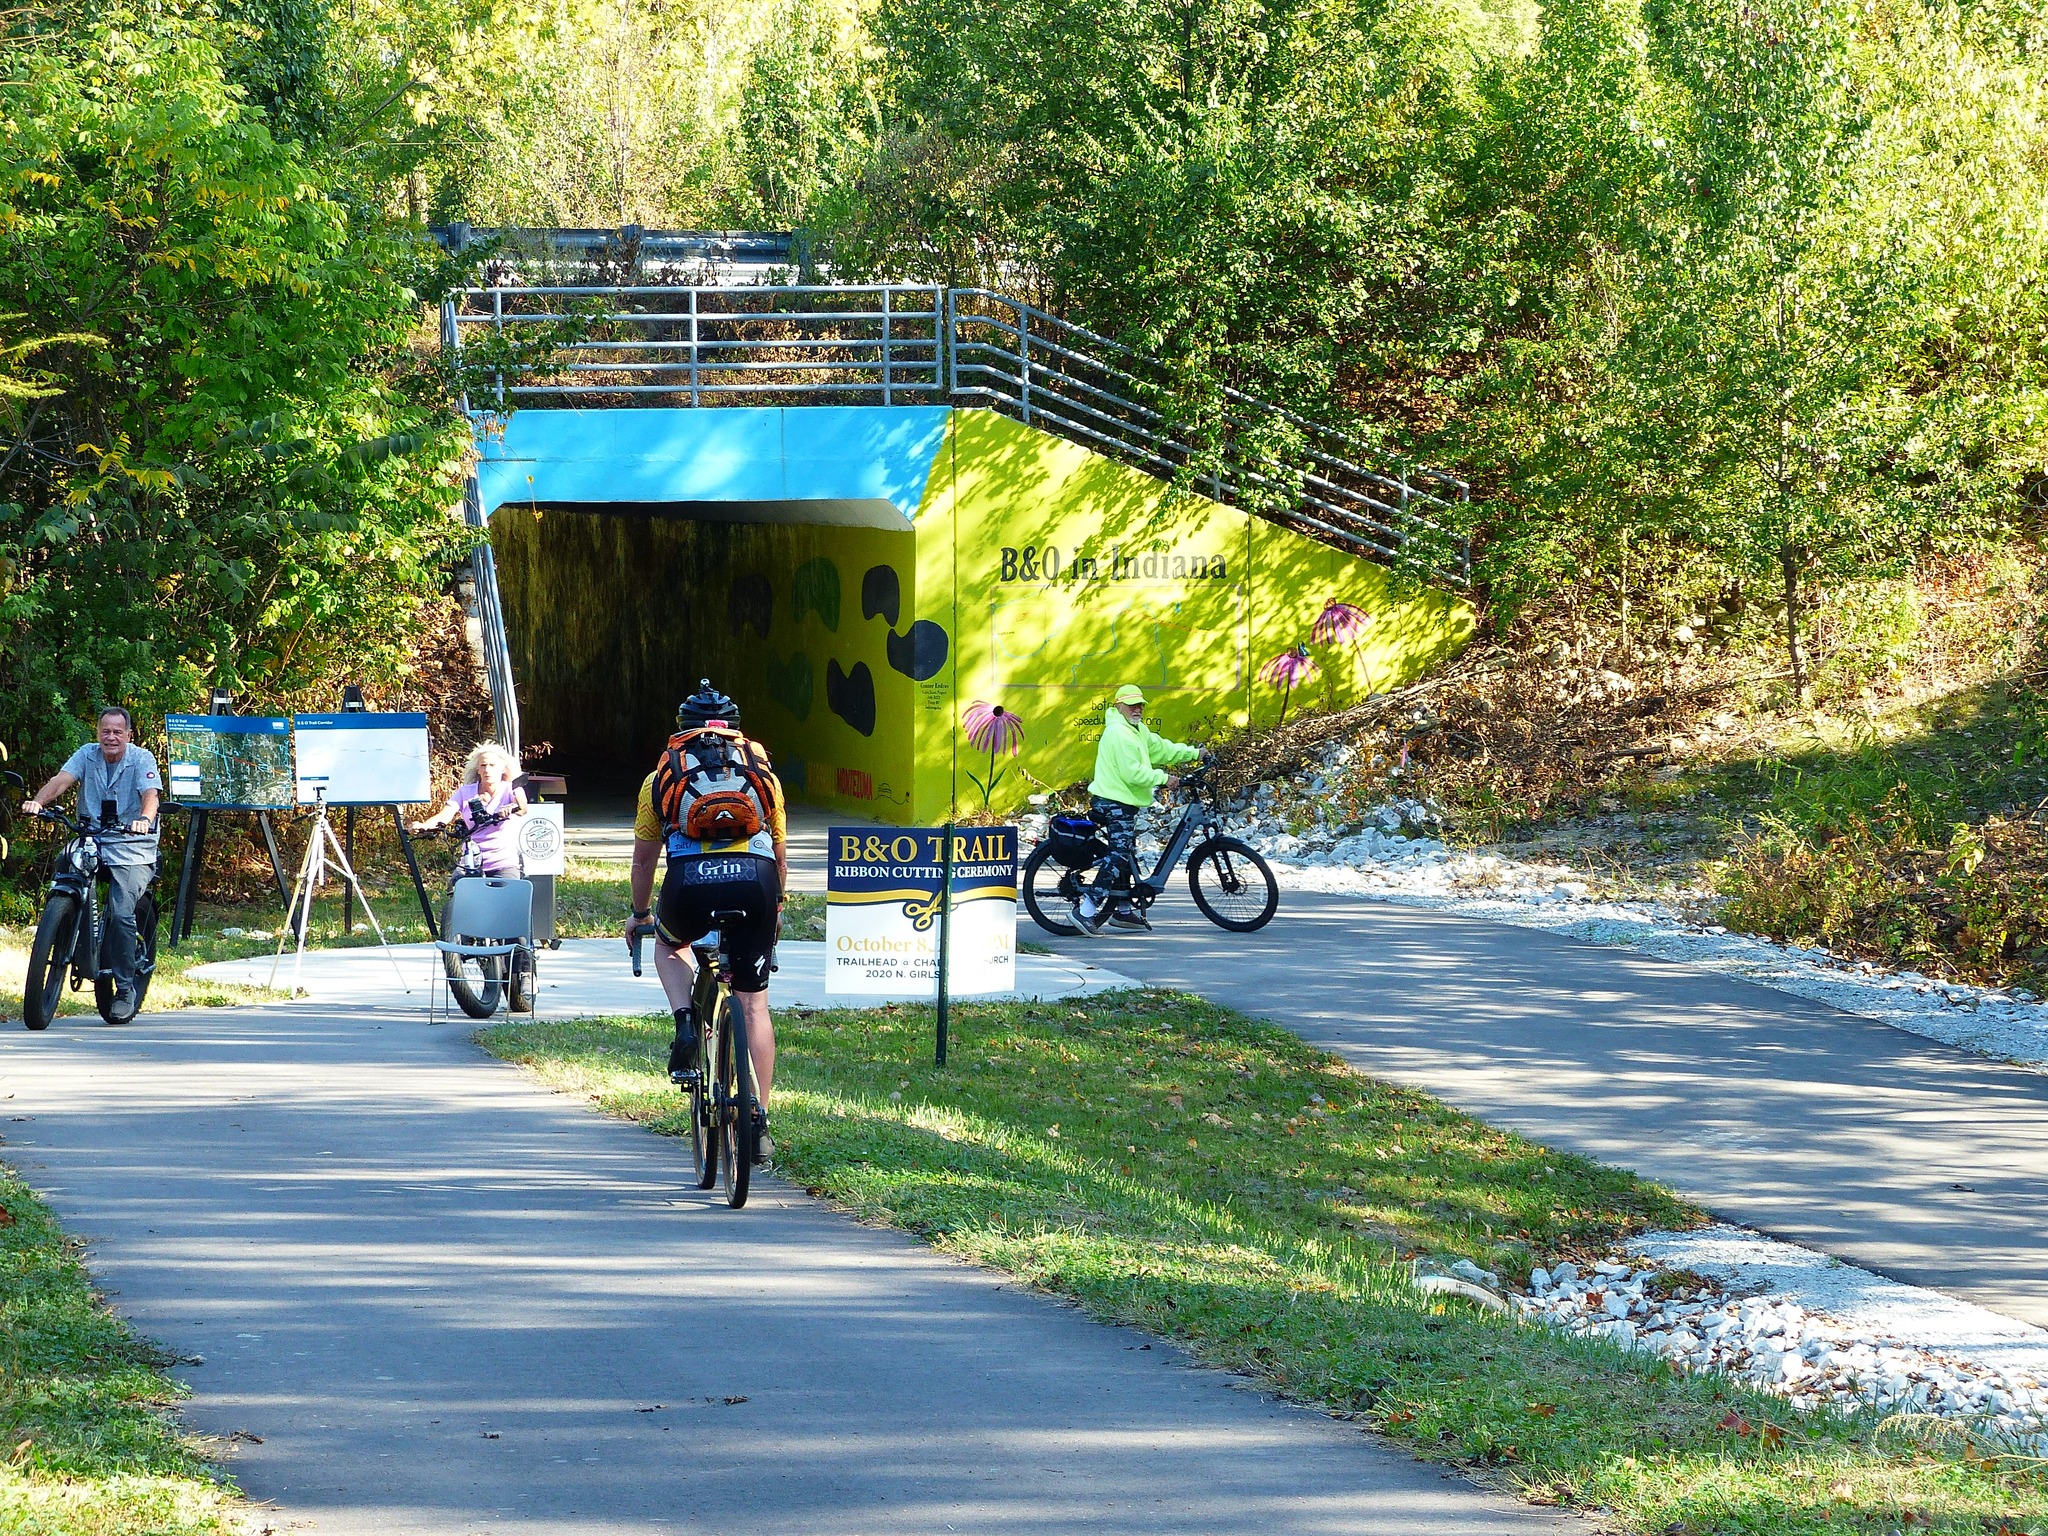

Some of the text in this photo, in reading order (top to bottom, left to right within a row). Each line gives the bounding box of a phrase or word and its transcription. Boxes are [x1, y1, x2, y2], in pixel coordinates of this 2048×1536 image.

[1000, 544, 1227, 583] B&O in Indiana
[838, 834, 1011, 863] B&O TRAIL
[698, 860, 741, 875] Grin
[834, 865, 890, 878] RIBBON
[957, 864, 1014, 878] CEREMONY
[836, 935, 912, 952] October
[836, 957, 898, 967] TRAILHEAD
[865, 969, 940, 979] 2020 N. GIRLS
